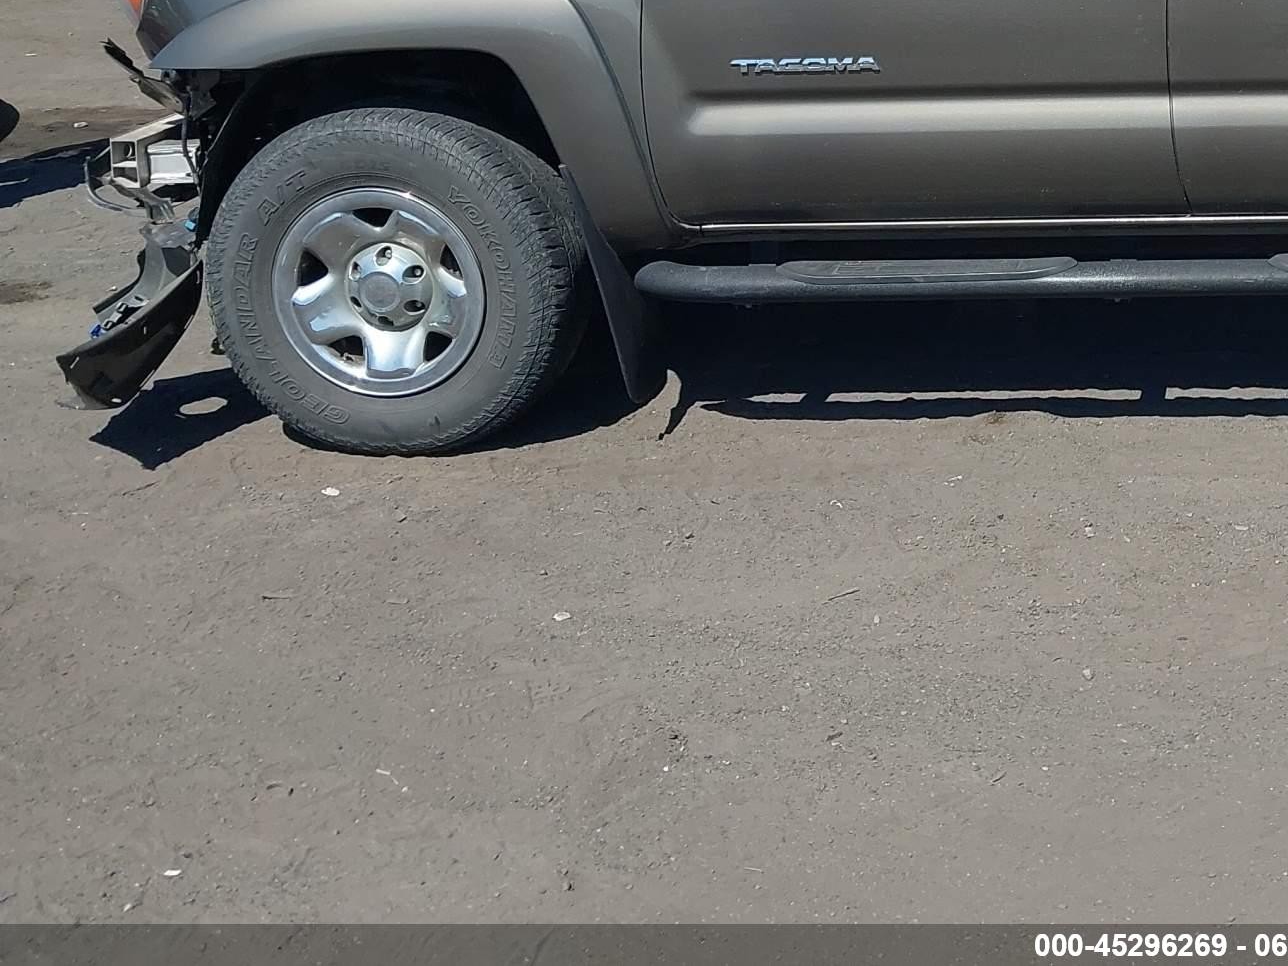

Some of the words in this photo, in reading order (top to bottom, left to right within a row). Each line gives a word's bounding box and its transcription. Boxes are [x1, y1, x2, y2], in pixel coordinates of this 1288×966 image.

[729, 56, 881, 75] TACOMA
[257, 169, 307, 226] A/T
[233, 233, 351, 425] GEOLANDAR
[448, 185, 518, 369] YOKOHAMA
